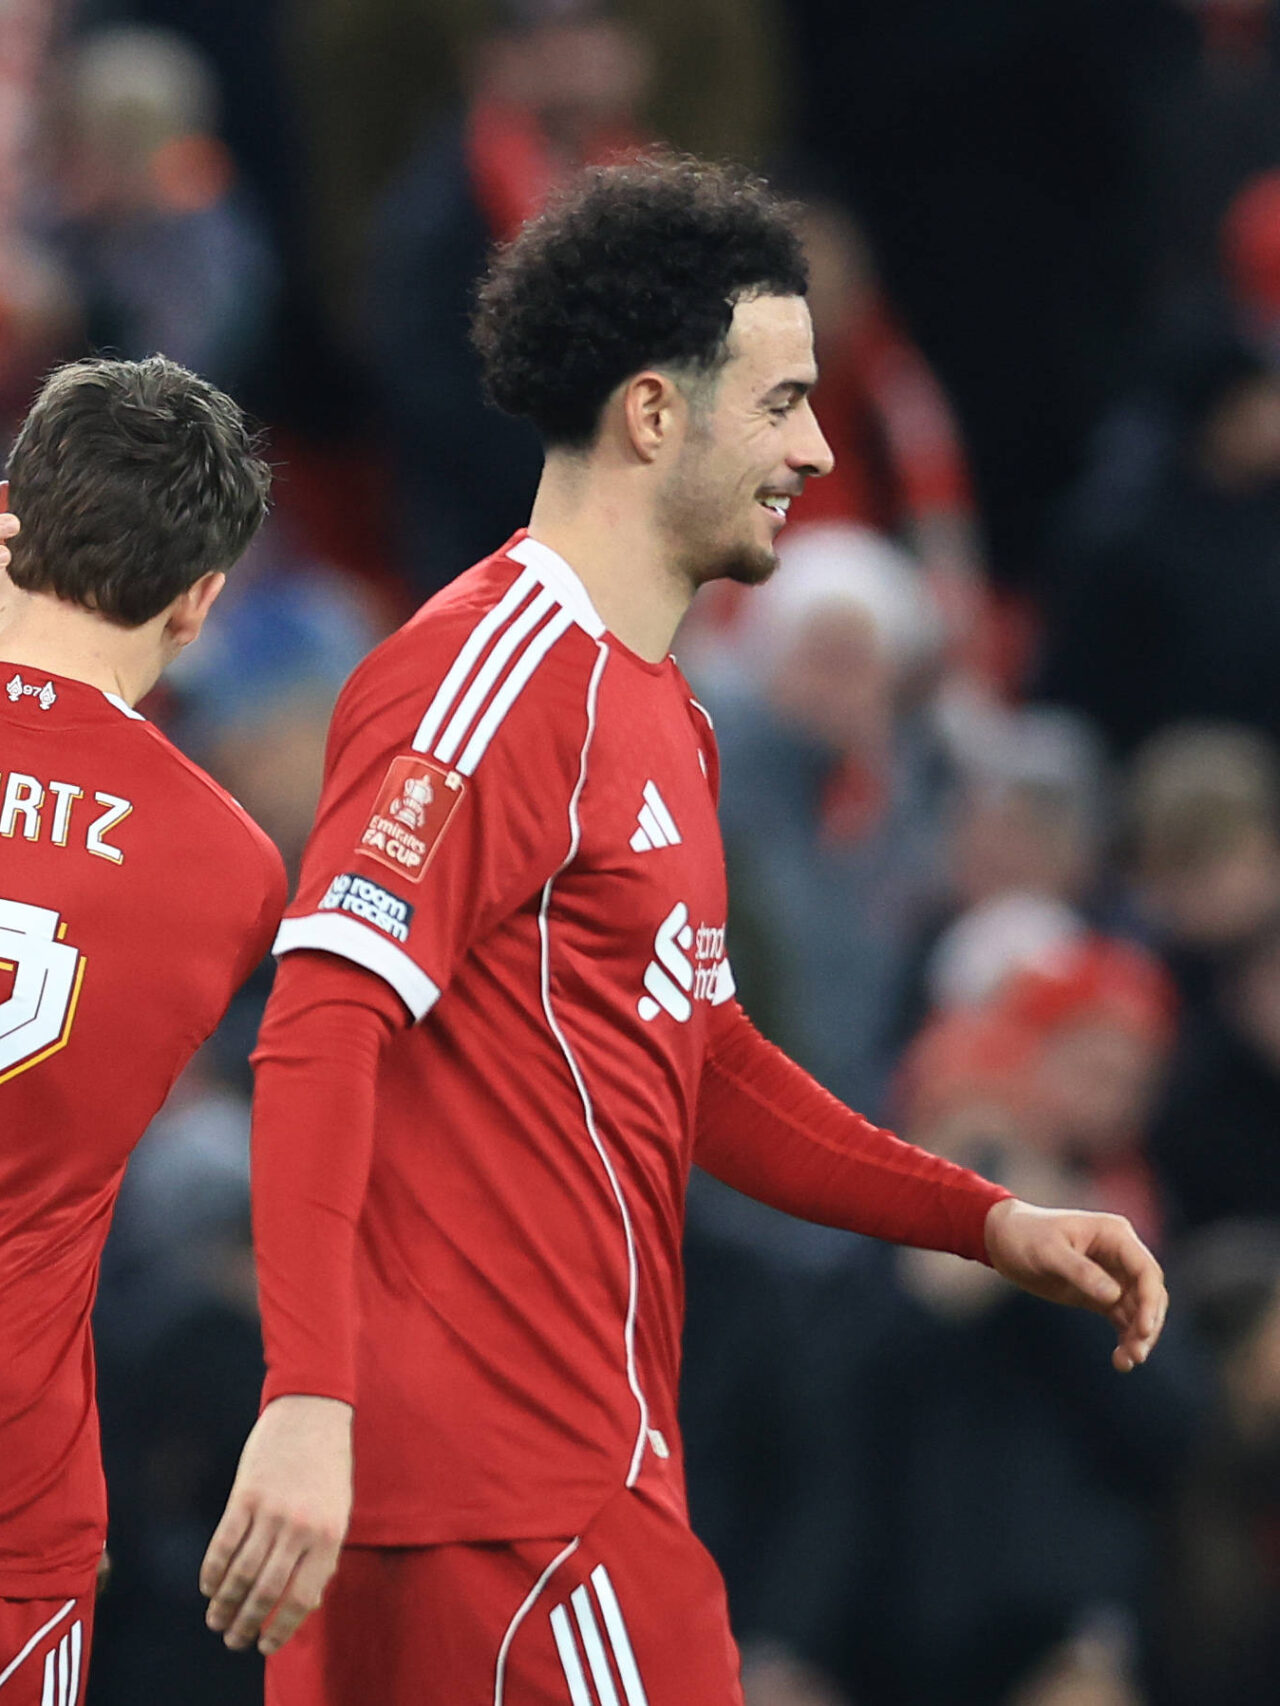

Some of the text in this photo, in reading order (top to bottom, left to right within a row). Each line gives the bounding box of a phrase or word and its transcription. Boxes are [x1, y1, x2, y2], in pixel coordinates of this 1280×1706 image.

[22, 684, 42, 697] 97
[361, 828, 422, 868] FA CUP
[368, 815, 427, 855] Emirates
[350, 877, 408, 922] room
